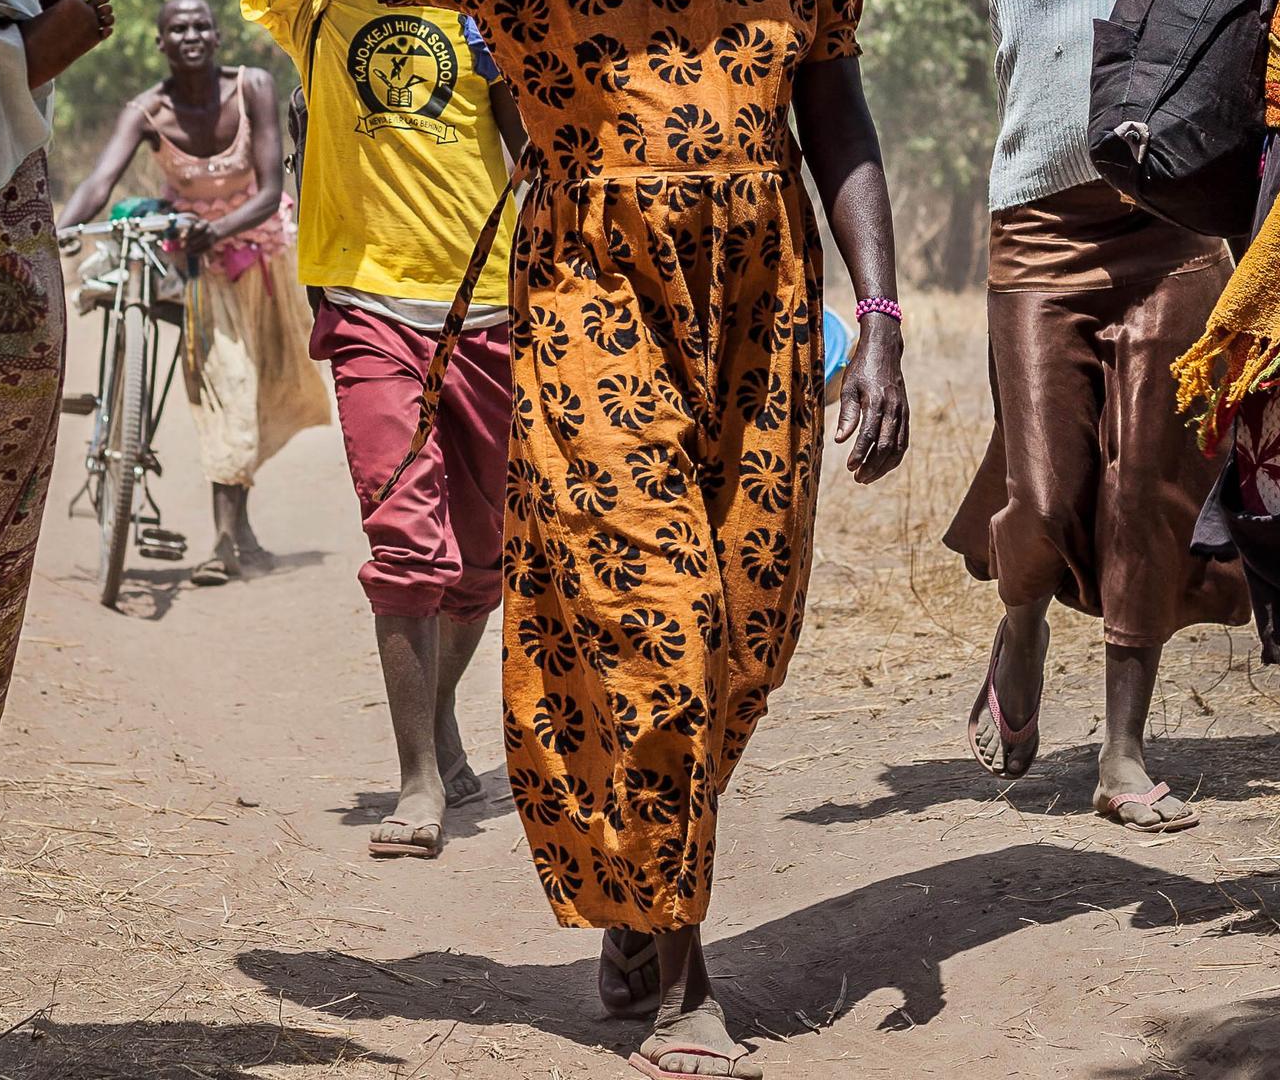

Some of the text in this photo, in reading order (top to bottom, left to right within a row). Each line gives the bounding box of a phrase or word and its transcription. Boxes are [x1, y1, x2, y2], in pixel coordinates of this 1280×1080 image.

[354, 20, 452, 88] KAJO-KEJI HIGH SCHOOL
[419, 120, 443, 133] BEHIND
